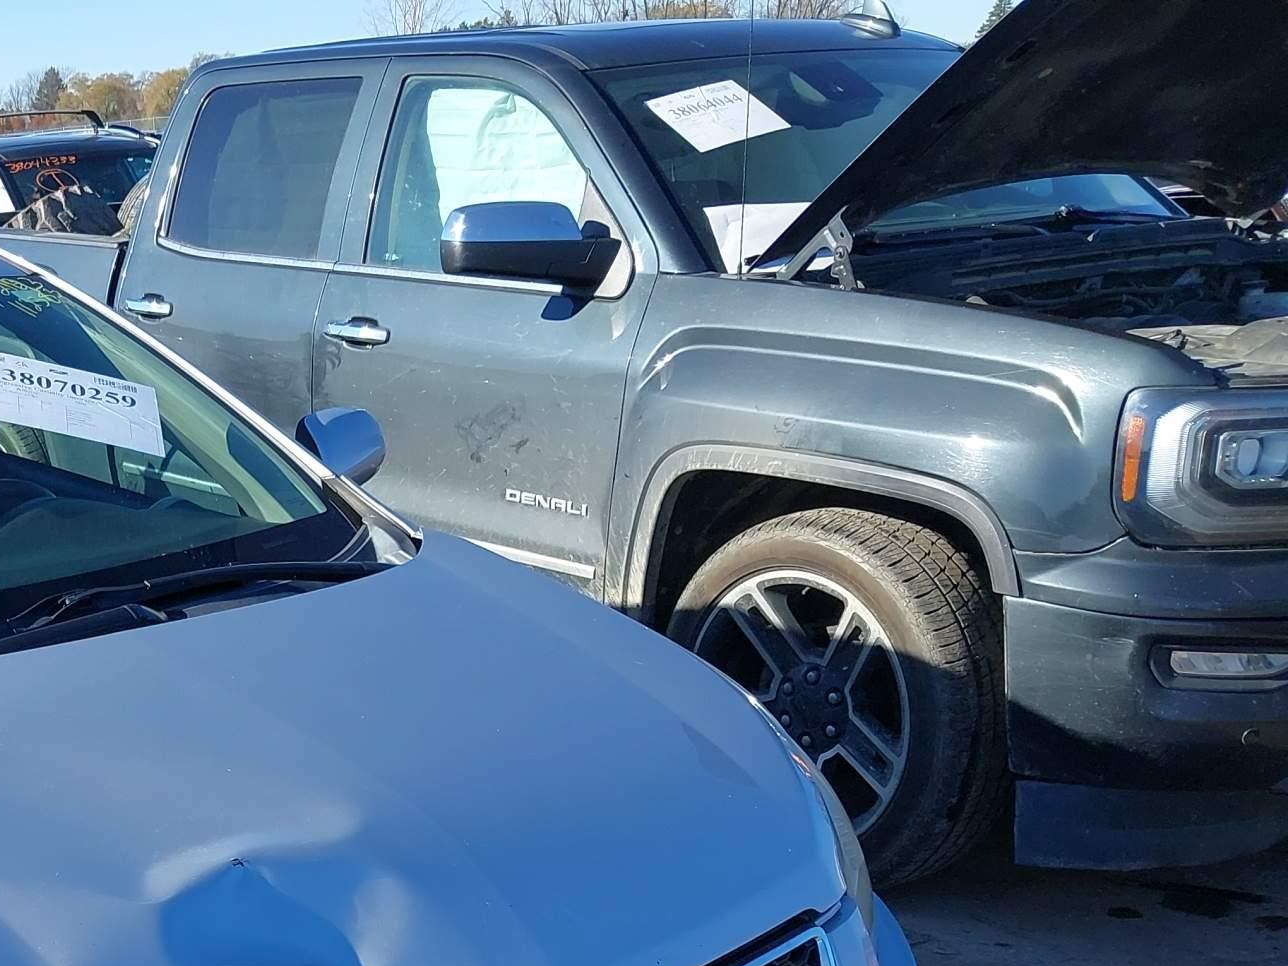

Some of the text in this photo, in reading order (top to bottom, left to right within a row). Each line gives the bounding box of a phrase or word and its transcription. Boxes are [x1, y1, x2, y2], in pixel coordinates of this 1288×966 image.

[668, 93, 743, 120] 38064044
[0, 368, 137, 408] 38070259
[505, 488, 589, 519] DENALI
